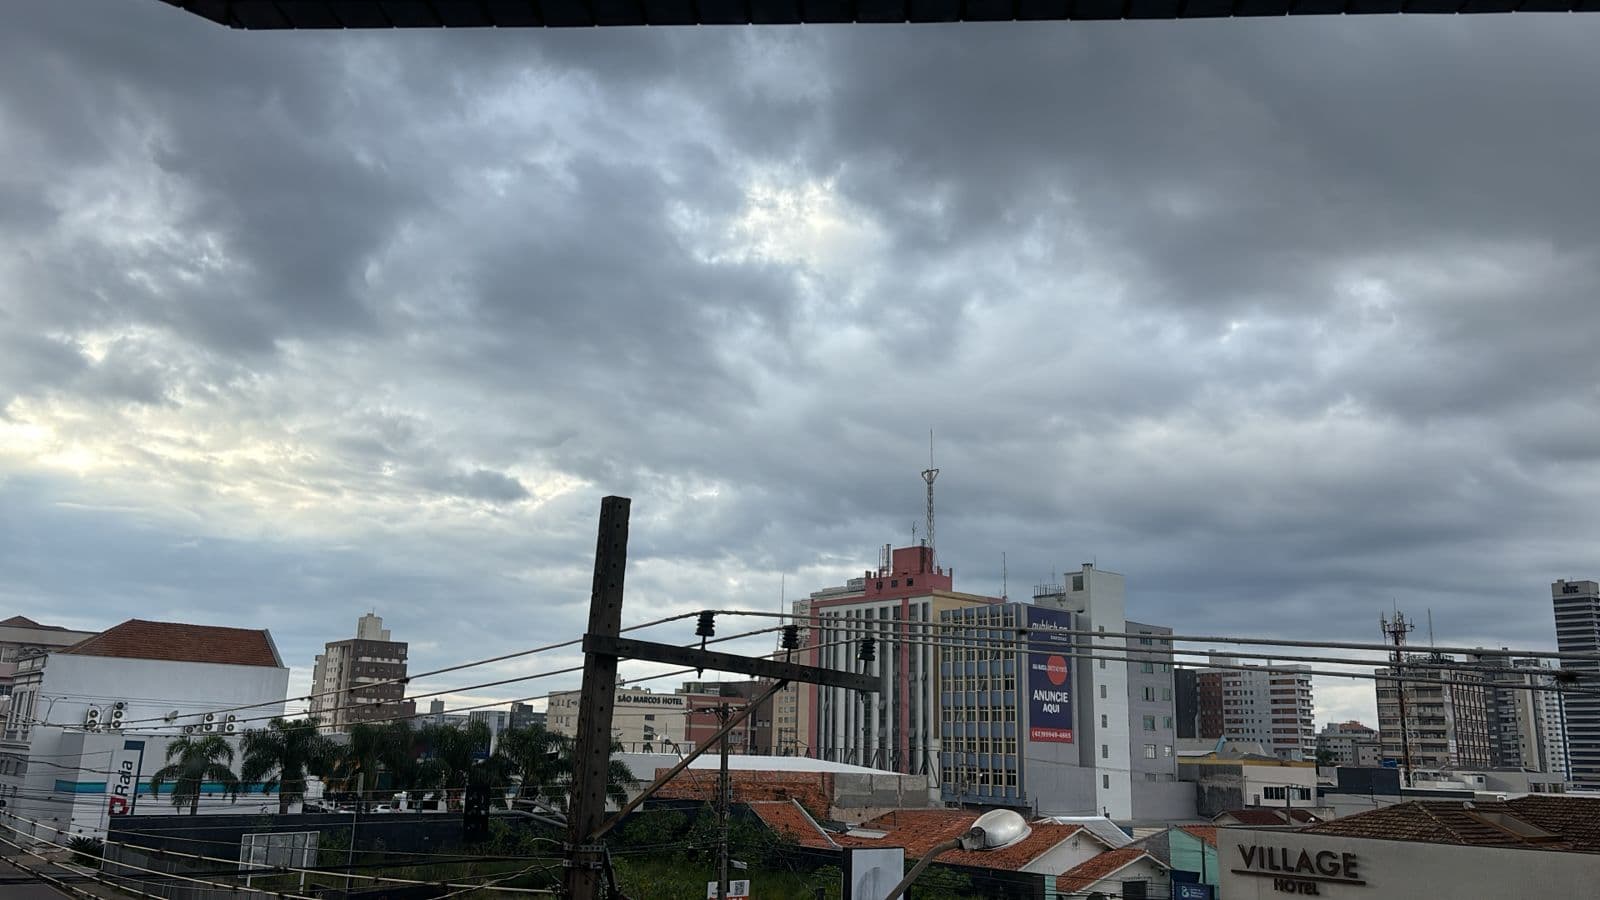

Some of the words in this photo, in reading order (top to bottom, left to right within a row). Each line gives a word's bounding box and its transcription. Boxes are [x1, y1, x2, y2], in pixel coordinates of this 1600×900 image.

[617, 694, 632, 703] SÃO
[633, 695, 661, 704] MARCOS
[662, 697, 683, 705] HOTEL
[1033, 689, 1068, 703] ANUNCIE
[1042, 703, 1060, 714] AQUI
[115, 760, 133, 797] Raia
[1237, 844, 1359, 879] VILLAGE
[1273, 878, 1320, 896] HOTEL
